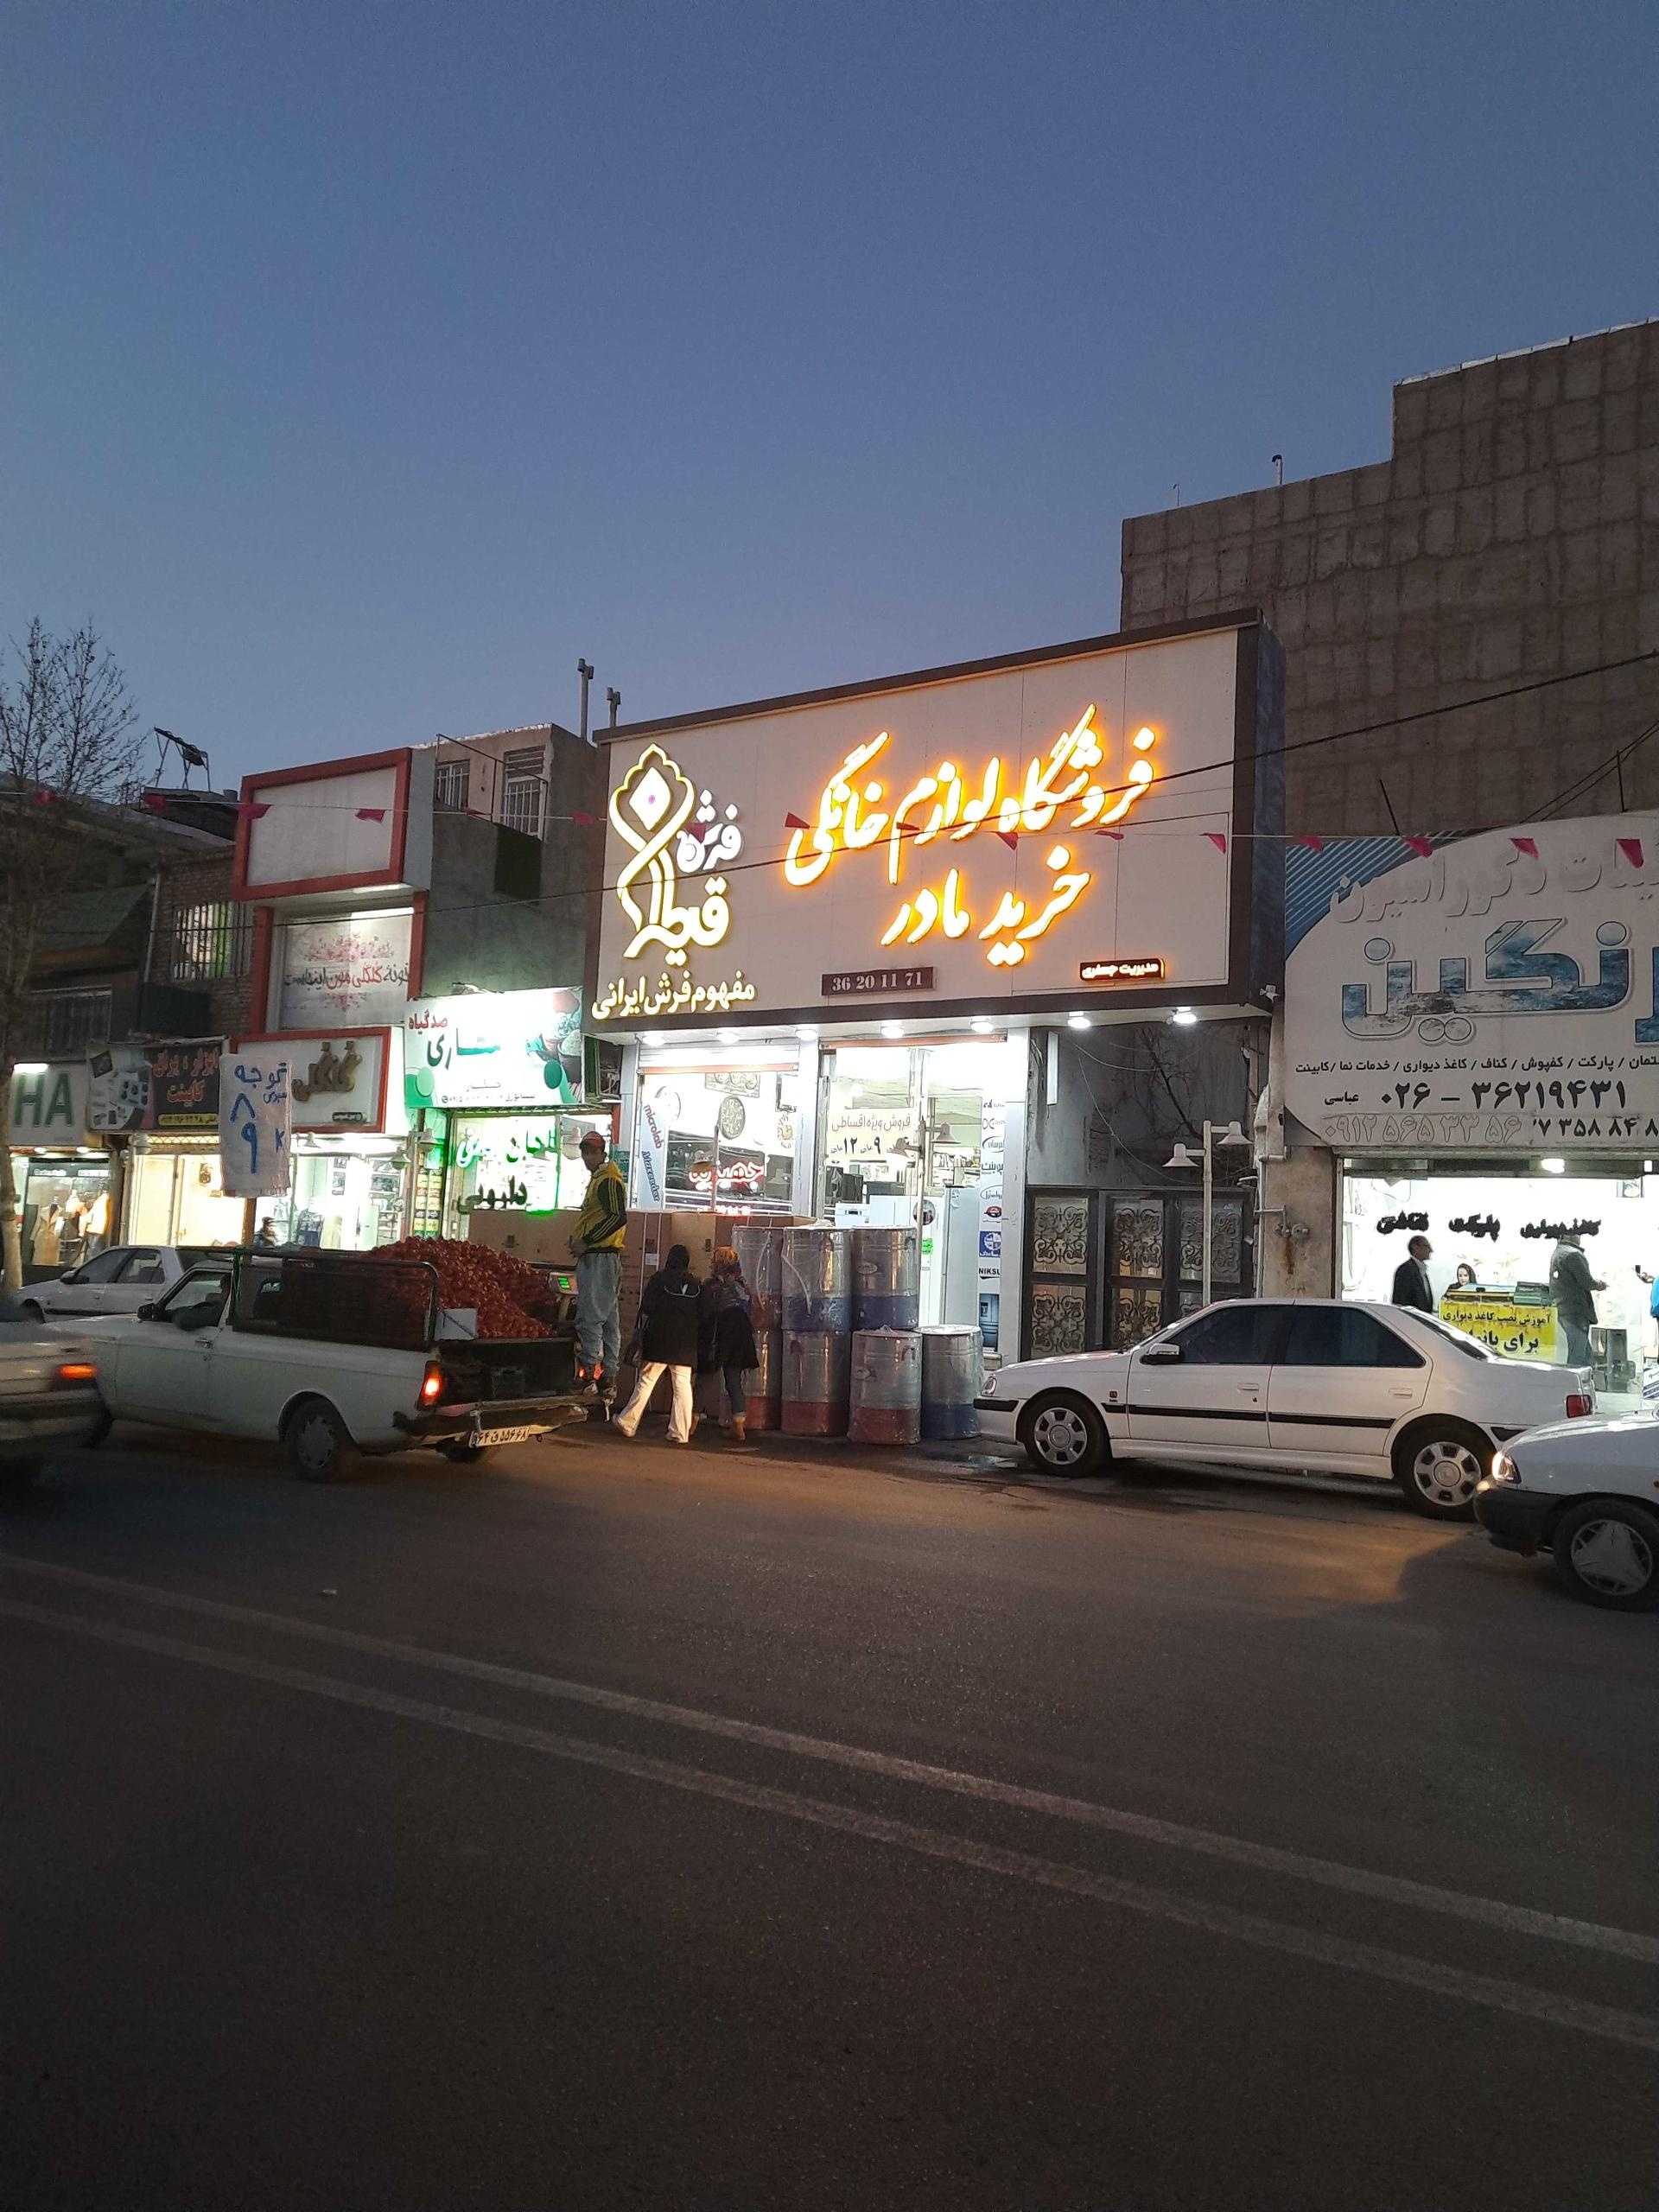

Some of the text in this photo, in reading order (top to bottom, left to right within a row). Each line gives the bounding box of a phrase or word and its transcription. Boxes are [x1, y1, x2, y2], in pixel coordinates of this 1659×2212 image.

[785, 702, 1155, 887] فروشگاه لوازم خانگی
[880, 844, 1090, 966] خرید مادر
[831, 972, 922, 991] 36 20 11 71
[591, 969, 756, 1020] مفهوم فرش ایرانی
[1339, 1059, 1353, 1071] نما
[1356, 1059, 1390, 1071] خدمات
[1403, 1059, 1440, 1074] دیواری
[1443, 1058, 1467, 1071] کاغذ
[1481, 1058, 1507, 1070] کناف
[1522, 1056, 1563, 1073] کفپوش
[1578, 1055, 1614, 1072] پارکت
[1629, 1055, 1659, 1070] تمان
[1324, 1090, 1360, 1106] عباسی
[1382, 1081, 1432, 1110] ۰۲۶
[1471, 1080, 1626, 1110] ۳۶۲۱۹۴۳۱
[867, 1115, 883, 1131] ویژه
[883, 1113, 912, 1132] فروش
[1558, 1118, 1602, 1138] ۳۵۸
[1608, 1116, 1638, 1138] ۸۴
[843, 1136, 858, 1154] ۱۲
[1442, 1309, 1551, 1327] آموزش نصب کاغذ دیواری
[1503, 1332, 1539, 1354] برای
